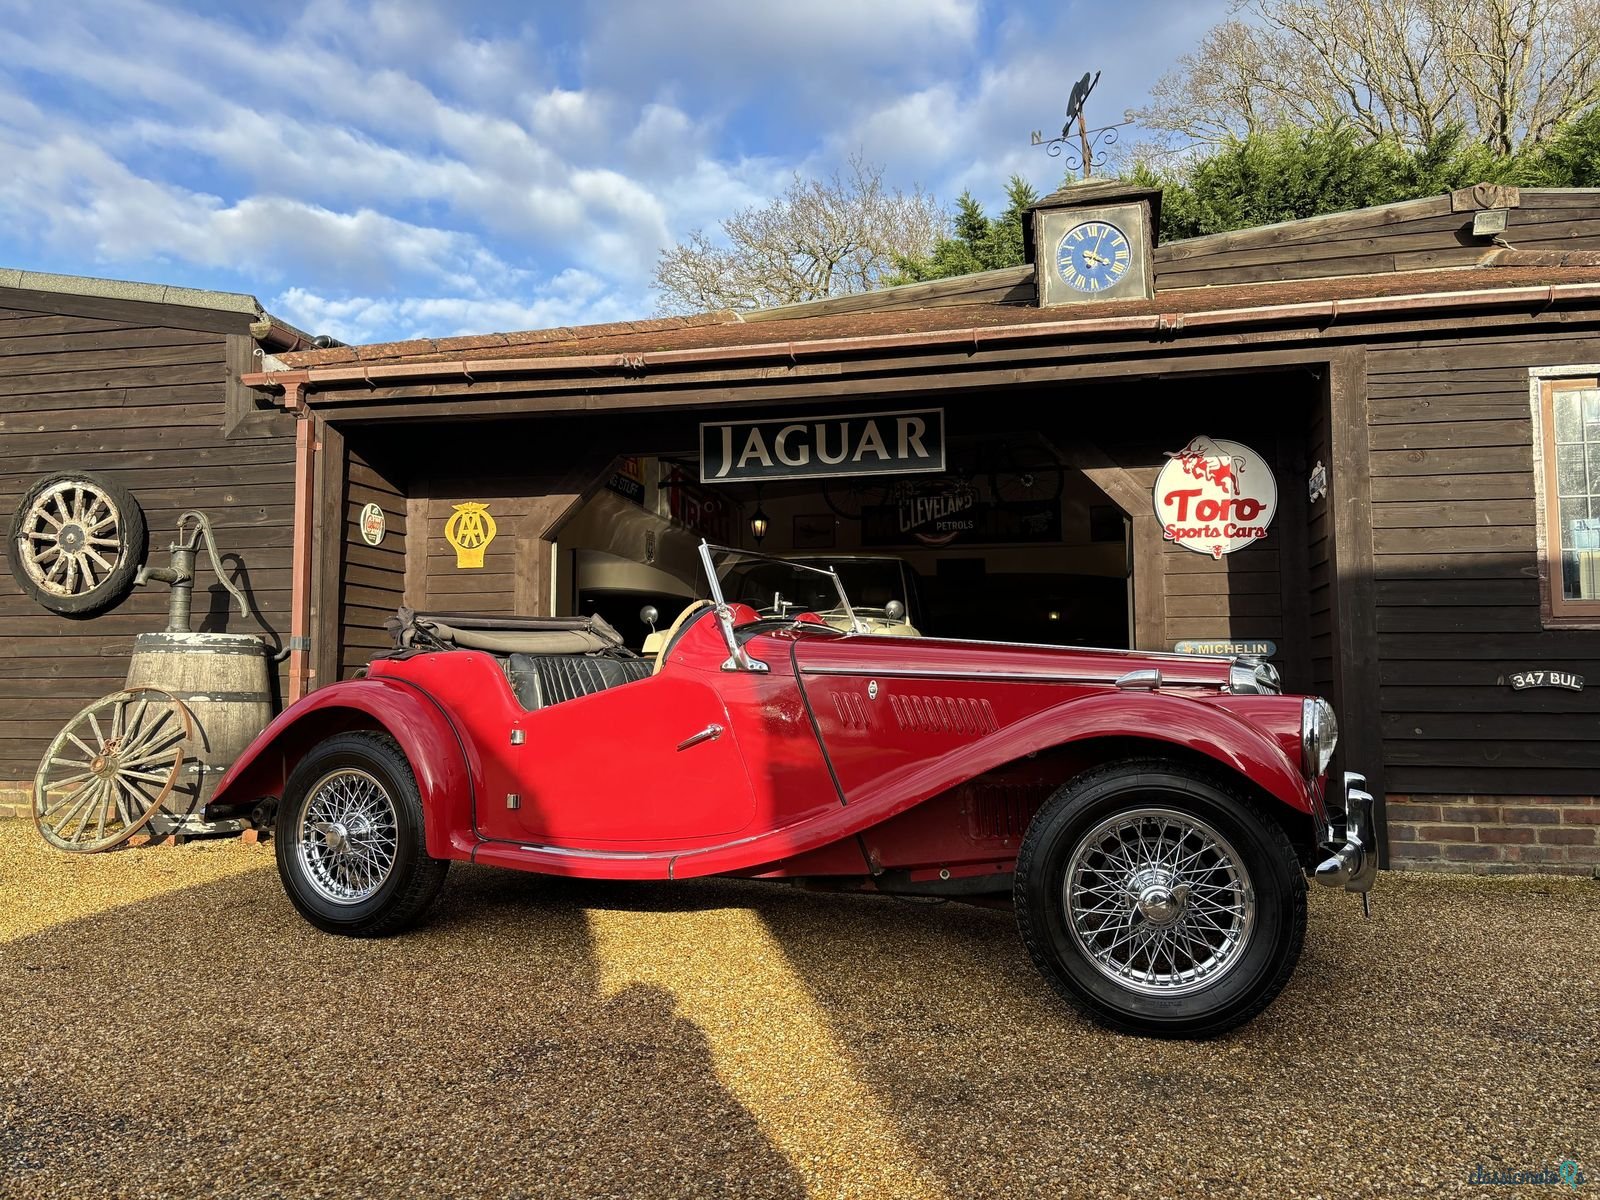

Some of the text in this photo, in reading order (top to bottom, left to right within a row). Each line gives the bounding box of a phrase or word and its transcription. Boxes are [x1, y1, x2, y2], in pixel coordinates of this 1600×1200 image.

[1031, 130, 1042, 144] N
[715, 417, 930, 477] JAGUAR
[899, 495, 973, 533] CLEVELAND
[1164, 488, 1267, 522] Toro
[936, 520, 974, 531] PETROLS
[1165, 522, 1267, 541] Sports Cars
[1198, 643, 1268, 654] MICHELIN
[1513, 672, 1581, 689] 347 BUL
